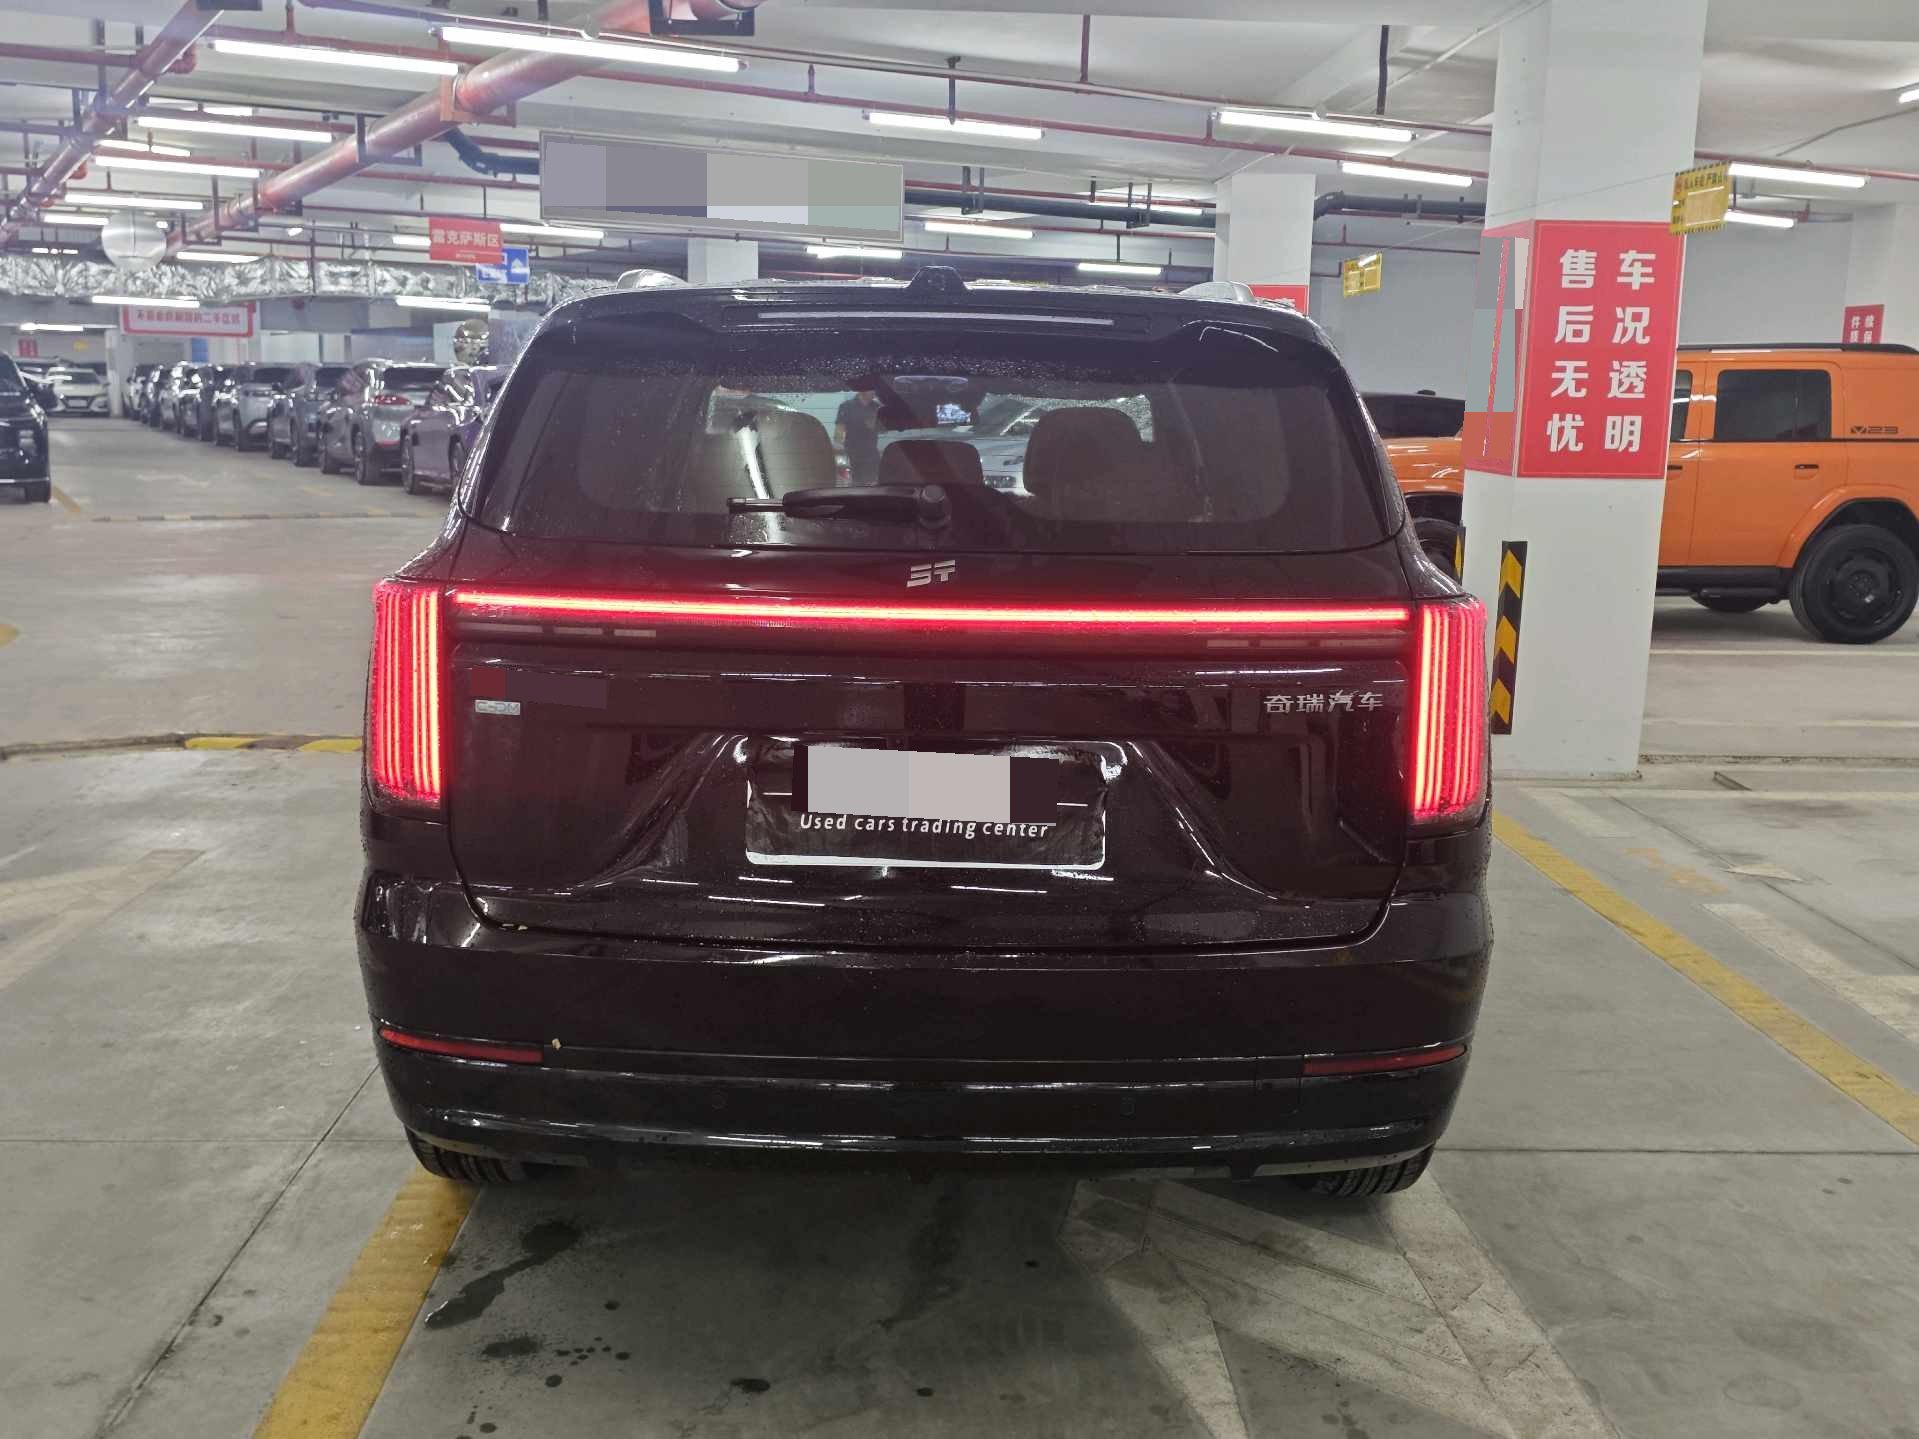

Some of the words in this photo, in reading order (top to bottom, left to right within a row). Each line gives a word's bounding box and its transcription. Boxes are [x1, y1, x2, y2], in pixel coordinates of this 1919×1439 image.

[1546, 249, 1598, 453] 售后无忧
[1603, 250, 1657, 453] 车况透明
[1264, 689, 1384, 713] 奇瑞汽车
[800, 813, 848, 830] Used
[854, 816, 895, 832] cars
[902, 816, 977, 839] trading
[982, 821, 1049, 838] center
